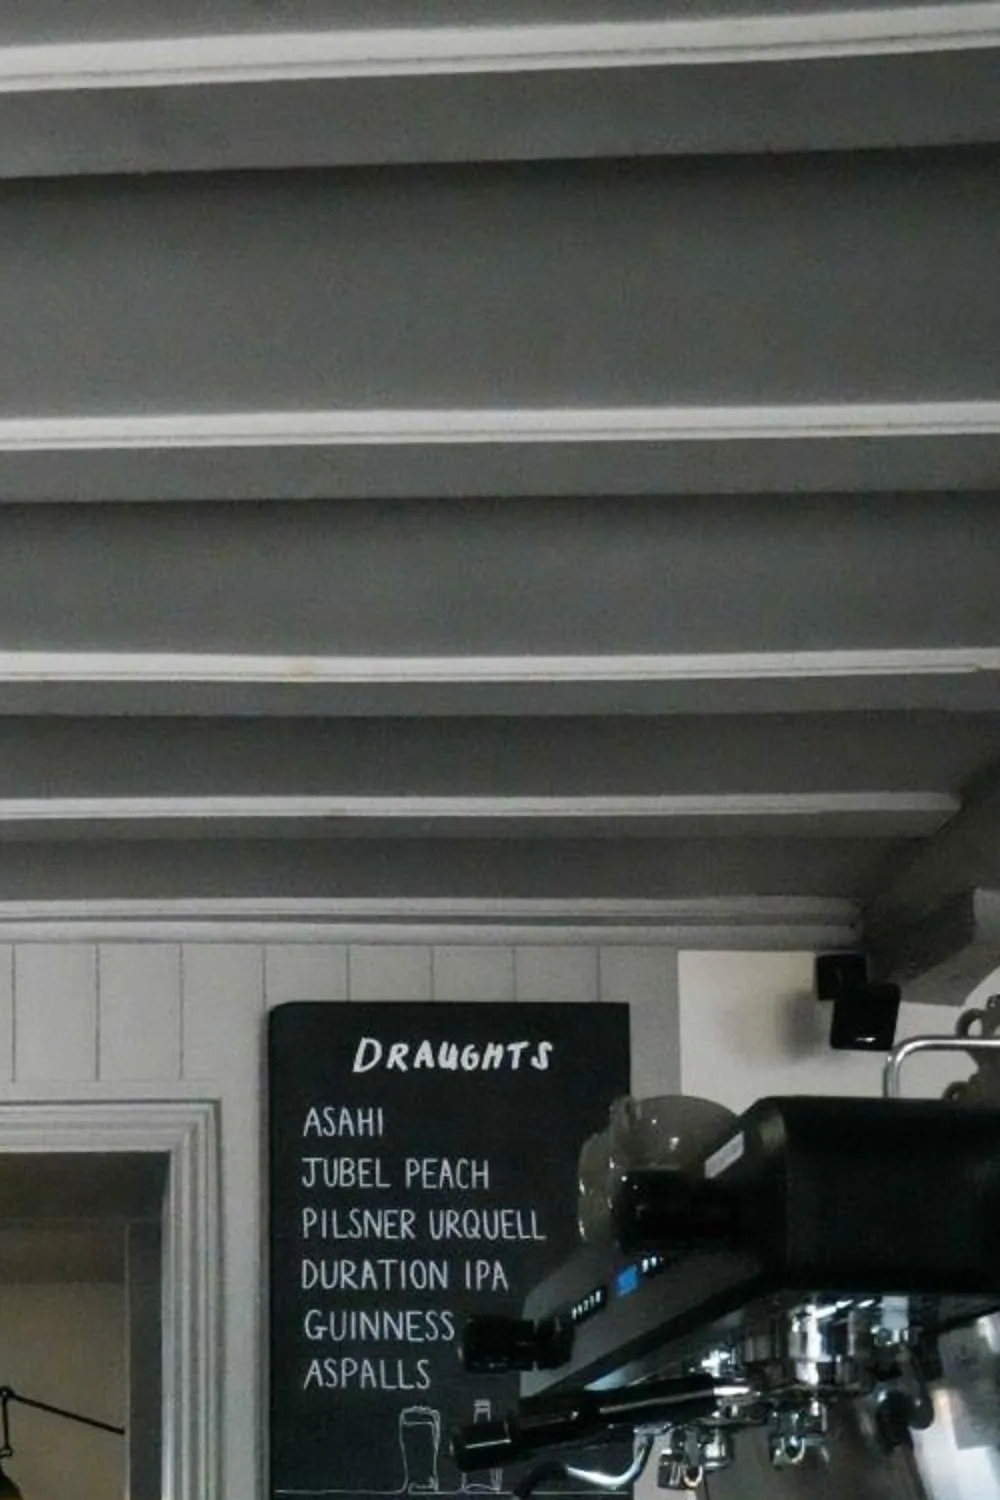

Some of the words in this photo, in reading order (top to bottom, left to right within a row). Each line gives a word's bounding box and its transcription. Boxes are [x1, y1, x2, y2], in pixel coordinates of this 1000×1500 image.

[353, 1037, 553, 1073] DRAUGHTS
[303, 1106, 384, 1137] ASAHI
[301, 1156, 391, 1189] JUBEL
[405, 1157, 489, 1190] PEACH
[302, 1207, 416, 1240] PILSNER
[429, 1208, 547, 1241] URQUELL
[301, 1258, 449, 1291] DURATION
[465, 1259, 509, 1291] IPA
[303, 1308, 456, 1343] GUINNESS
[303, 1357, 431, 1390] ASPALLS
